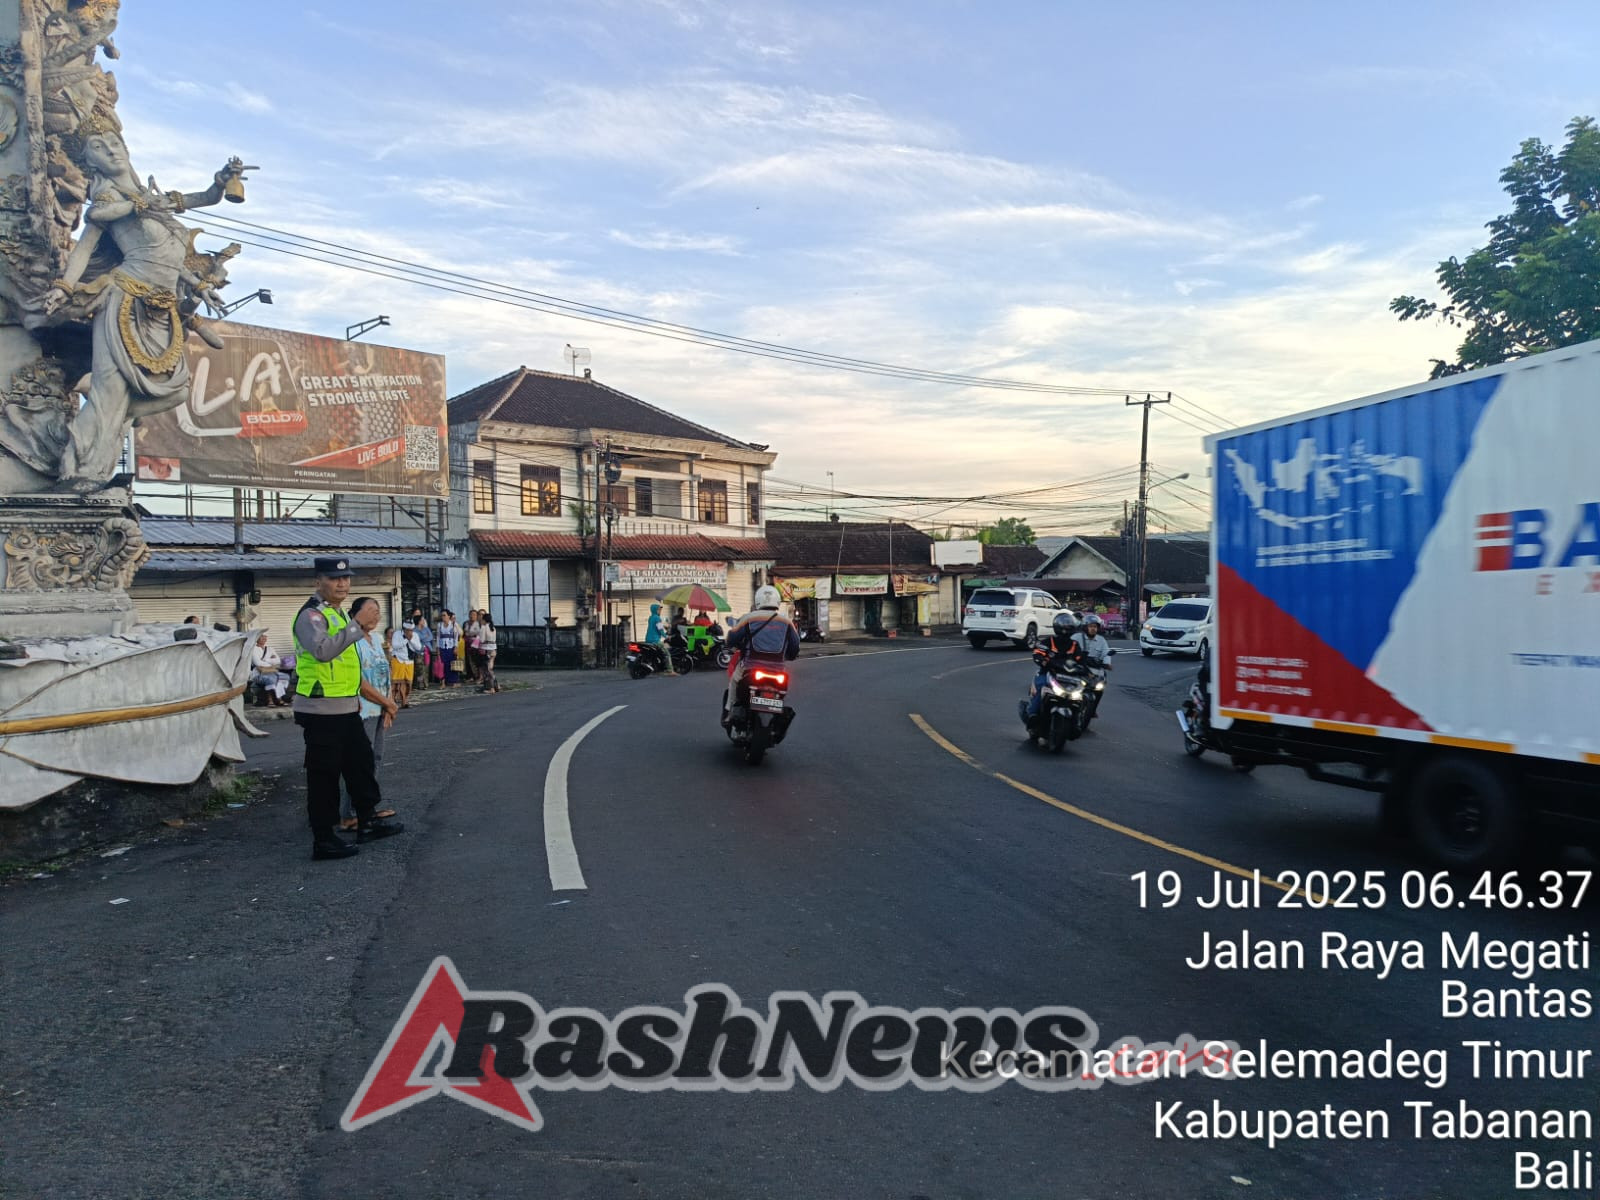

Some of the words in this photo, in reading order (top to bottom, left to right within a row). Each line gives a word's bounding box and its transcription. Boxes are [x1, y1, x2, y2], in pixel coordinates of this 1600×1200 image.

[300, 376, 350, 391] GREAT
[350, 374, 423, 388] SATISFACTION
[307, 390, 378, 407] STRONGER
[378, 390, 411, 402] TASTE
[246, 412, 292, 425] BOLD
[357, 448, 377, 465] LIVE
[377, 440, 399, 458] BOLD
[406, 461, 426, 470] SCAN
